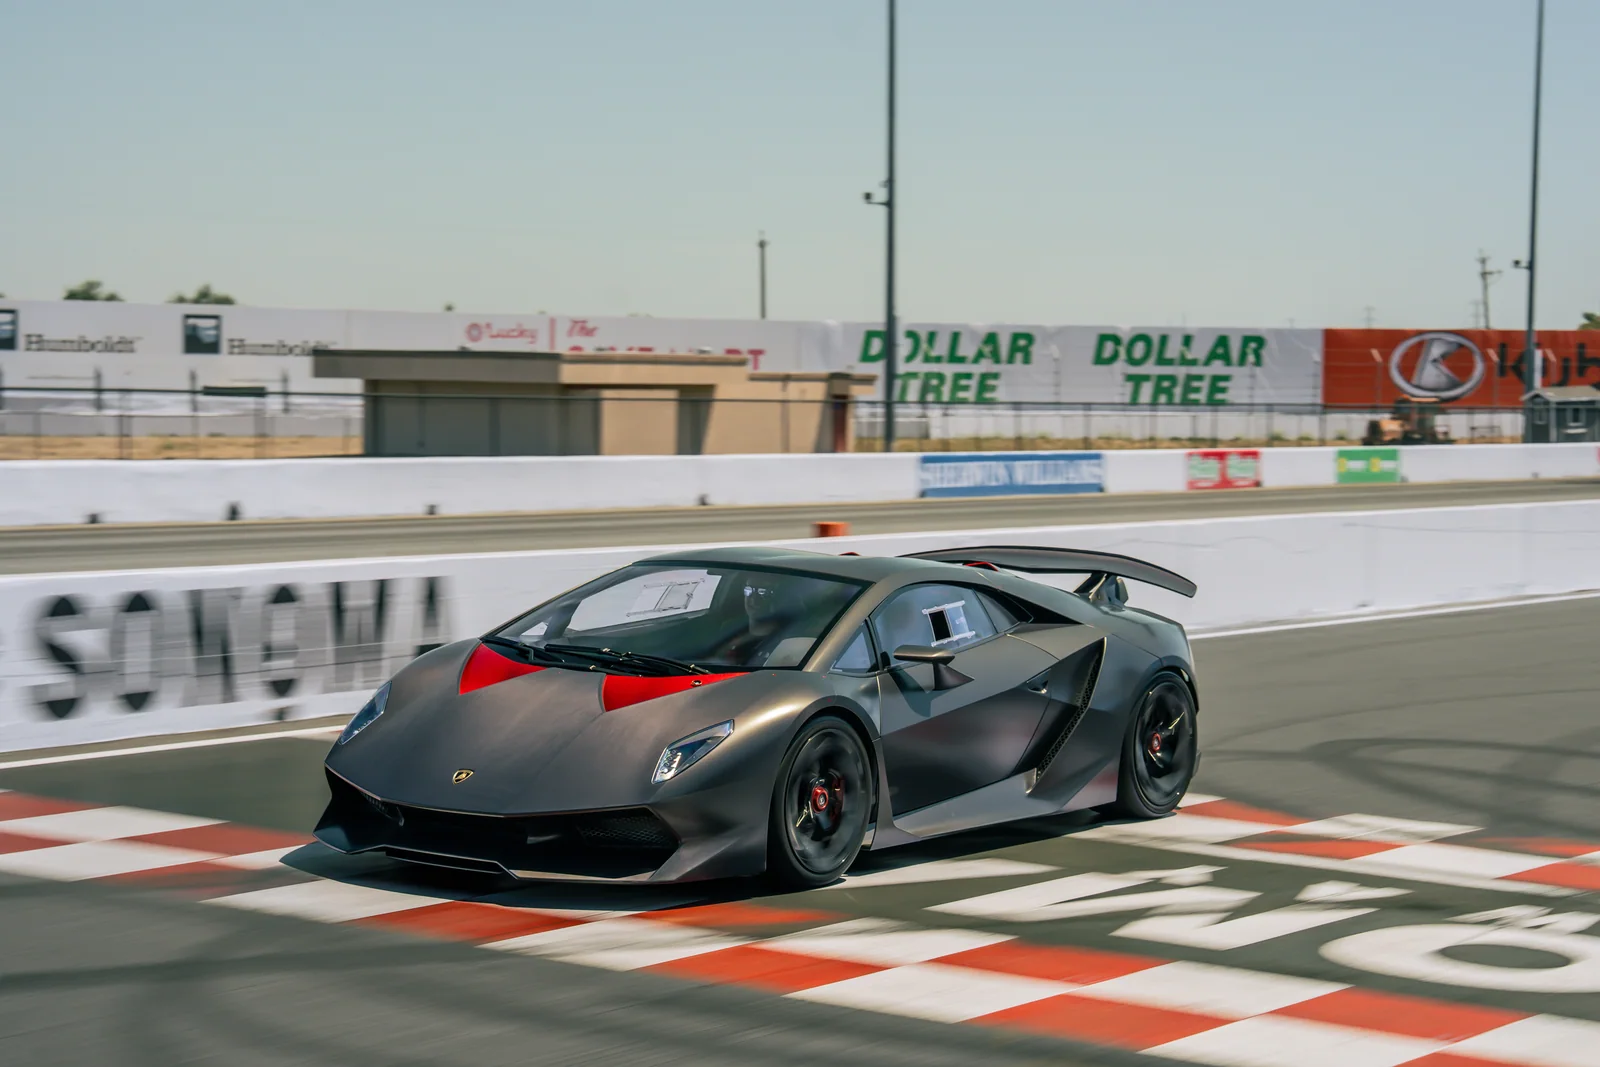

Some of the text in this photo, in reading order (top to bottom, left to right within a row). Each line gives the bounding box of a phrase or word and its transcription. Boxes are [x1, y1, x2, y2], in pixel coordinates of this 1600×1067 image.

[25, 334, 136, 353] Humboldt
[566, 318, 599, 338] The
[1092, 333, 1266, 367] DOLLAR
[896, 371, 1001, 403] TREE
[1126, 374, 1232, 405] TREE
